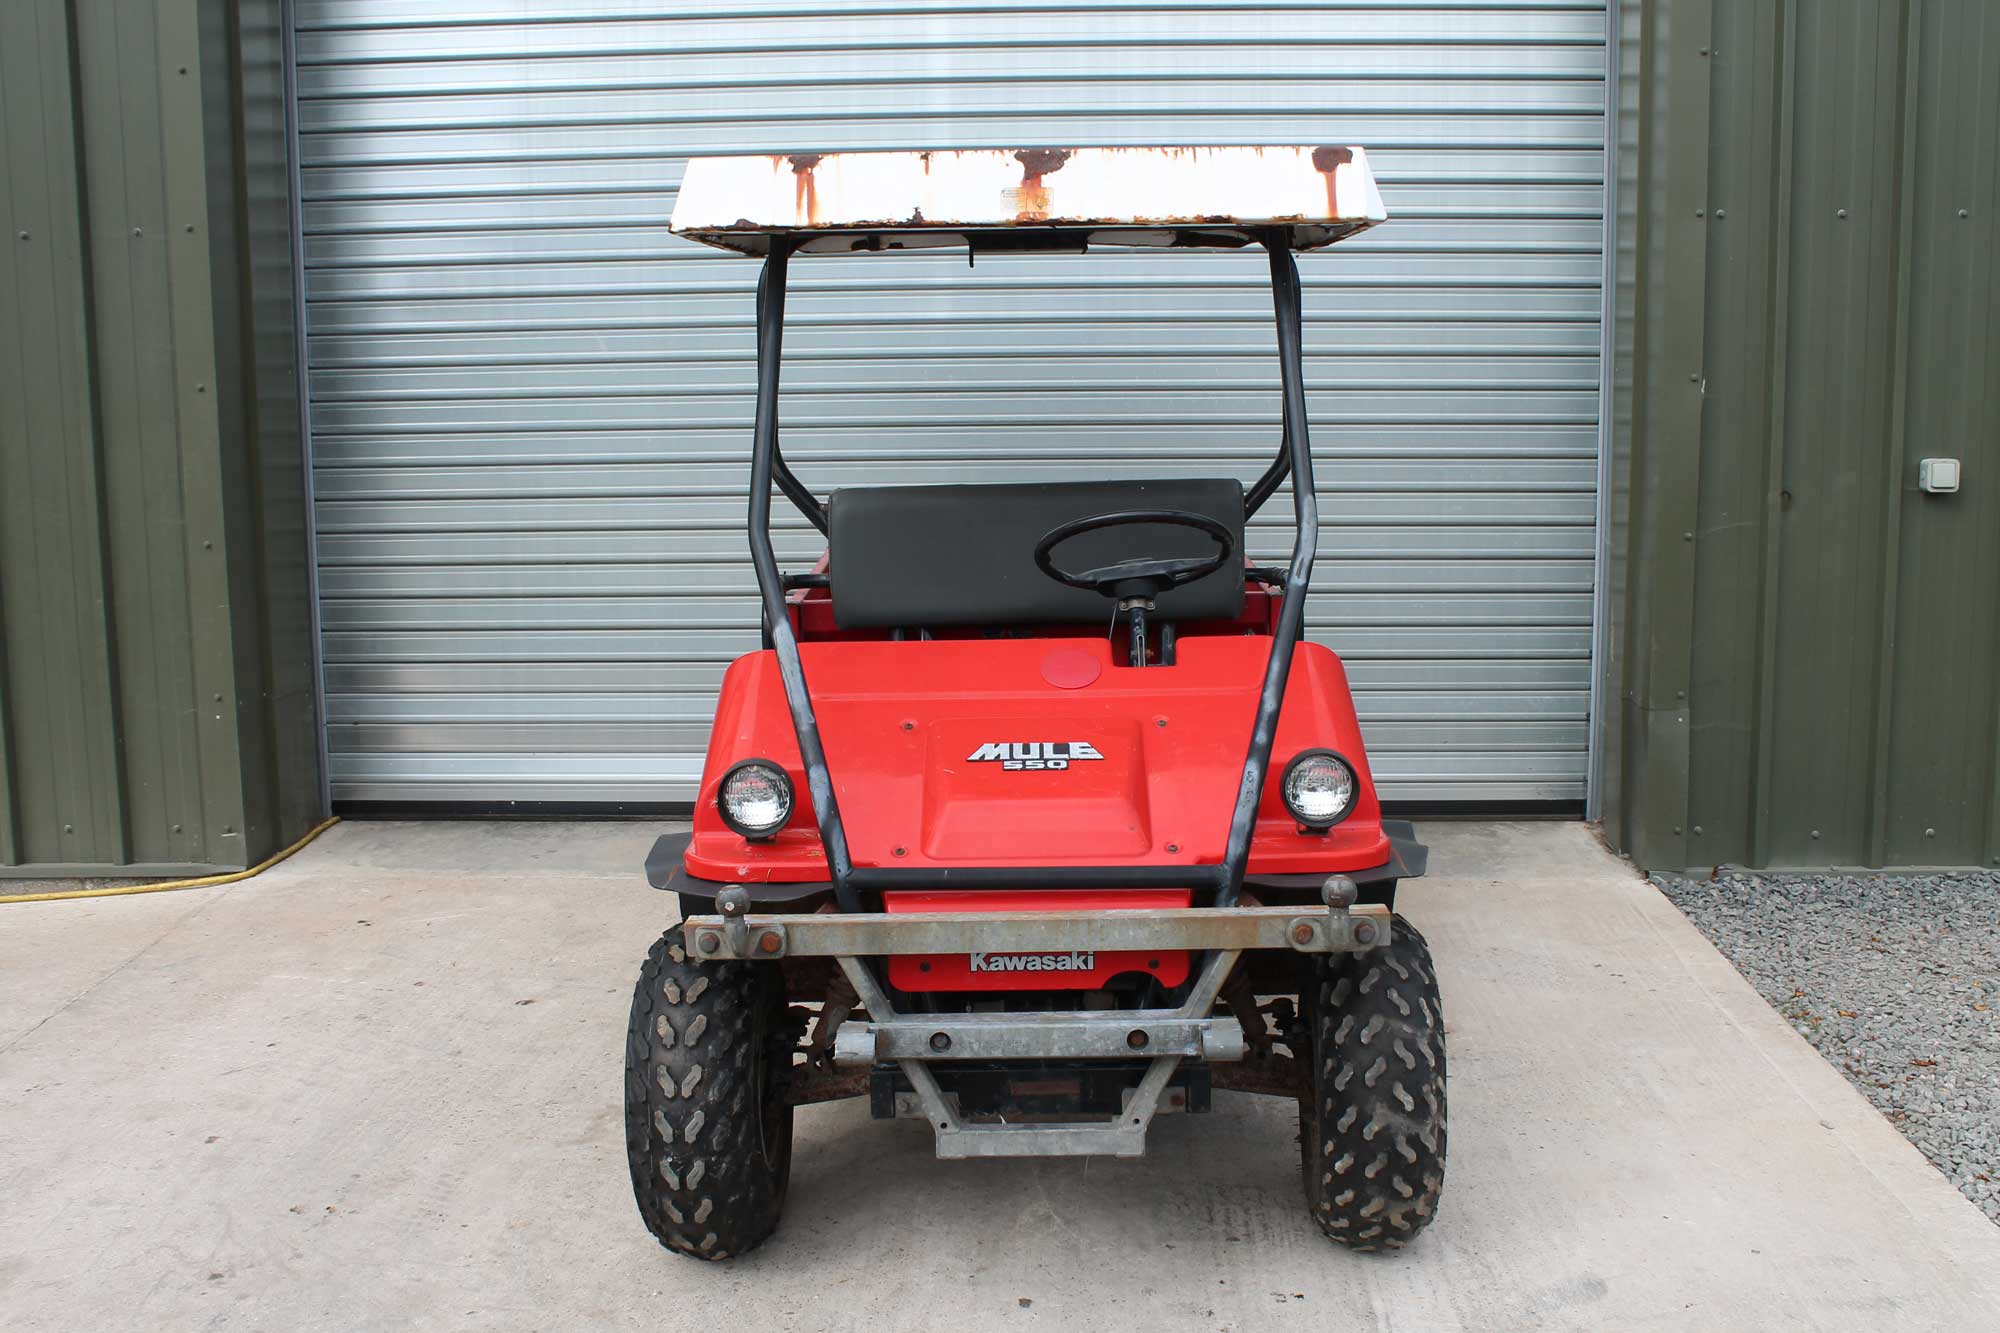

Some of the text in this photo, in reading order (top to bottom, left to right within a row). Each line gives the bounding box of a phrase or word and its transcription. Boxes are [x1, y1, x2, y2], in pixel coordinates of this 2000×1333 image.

[967, 742, 1104, 760] MULE
[1003, 760, 1068, 769] 550
[970, 951, 1094, 971] Kawasaki
